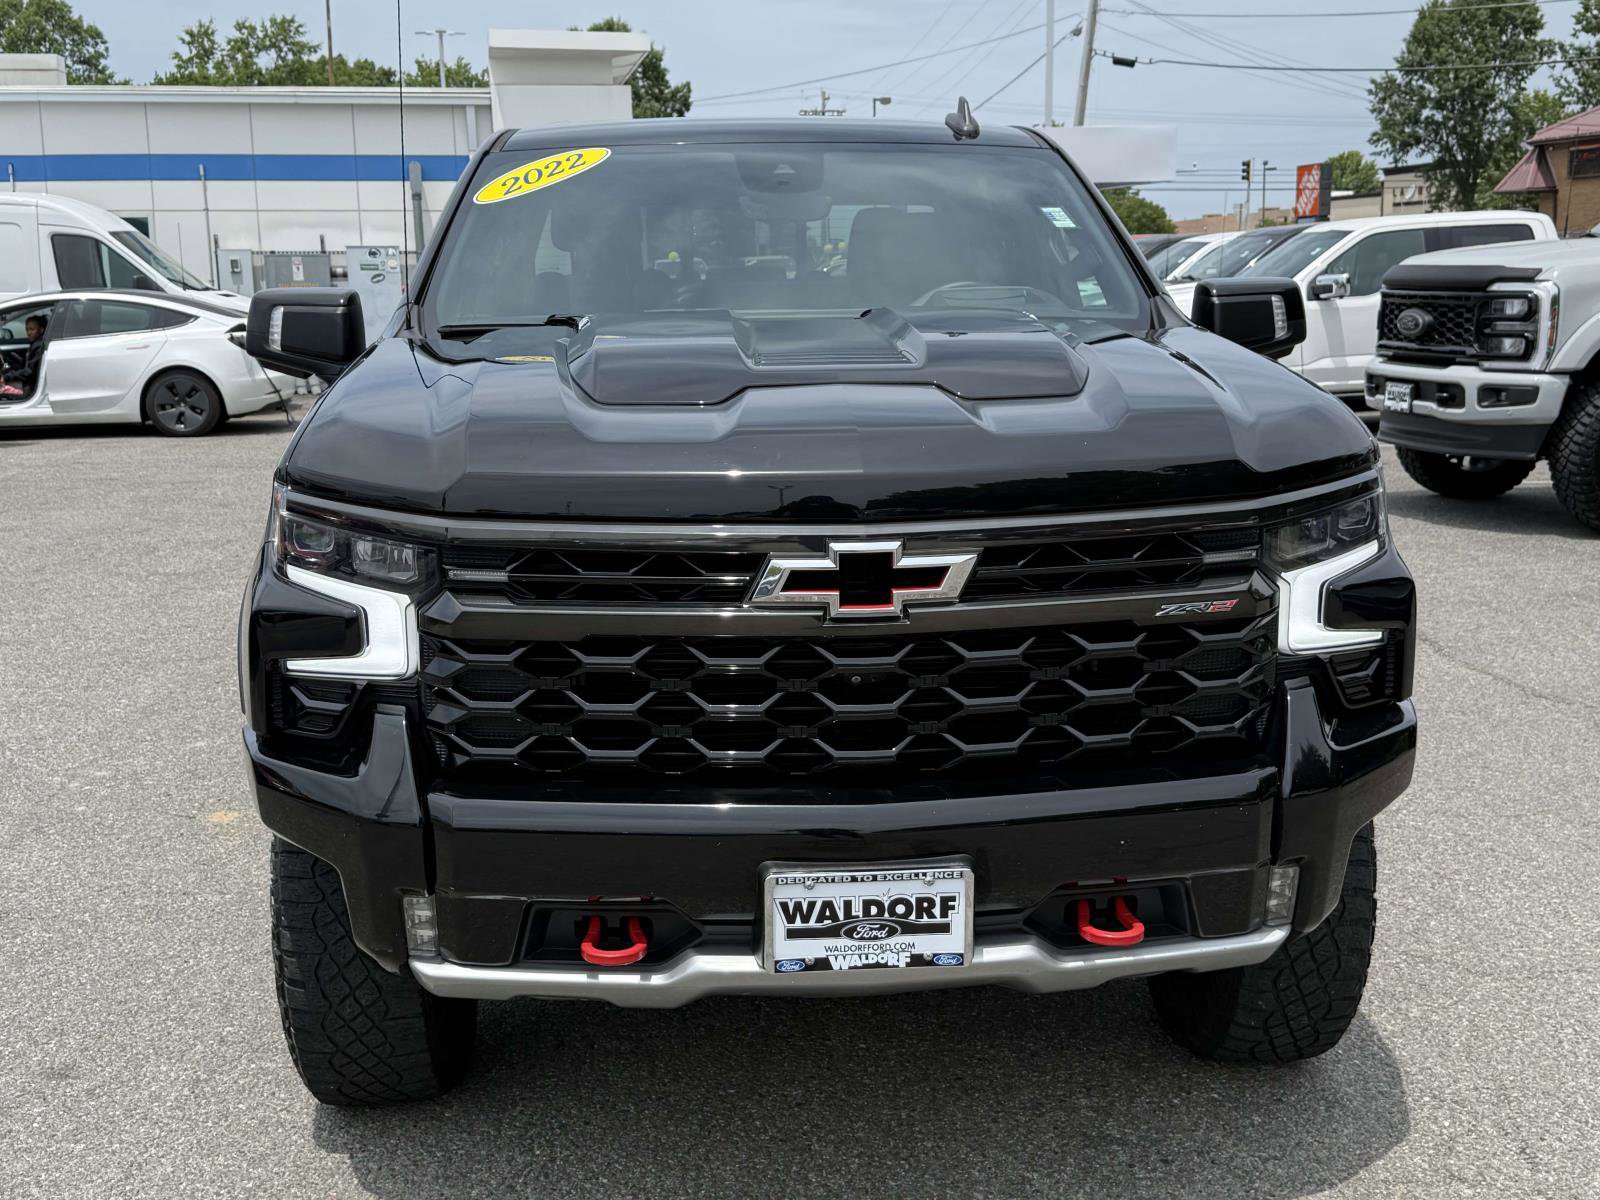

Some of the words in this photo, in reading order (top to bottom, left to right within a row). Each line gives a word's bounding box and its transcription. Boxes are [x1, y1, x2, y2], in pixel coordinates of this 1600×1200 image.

[501, 153, 586, 196] 2022
[1154, 598, 1240, 617] ZR2
[778, 875, 852, 885] DEDICATED
[856, 874, 873, 882] TO
[877, 871, 961, 881] EXCELLENCE
[778, 895, 957, 925] WALDORF
[853, 924, 889, 938] Ford
[824, 941, 916, 953] WALDORFFORD.COM
[780, 961, 801, 971] Ford
[827, 951, 912, 970] WALDORF
[939, 955, 959, 965] Ford
